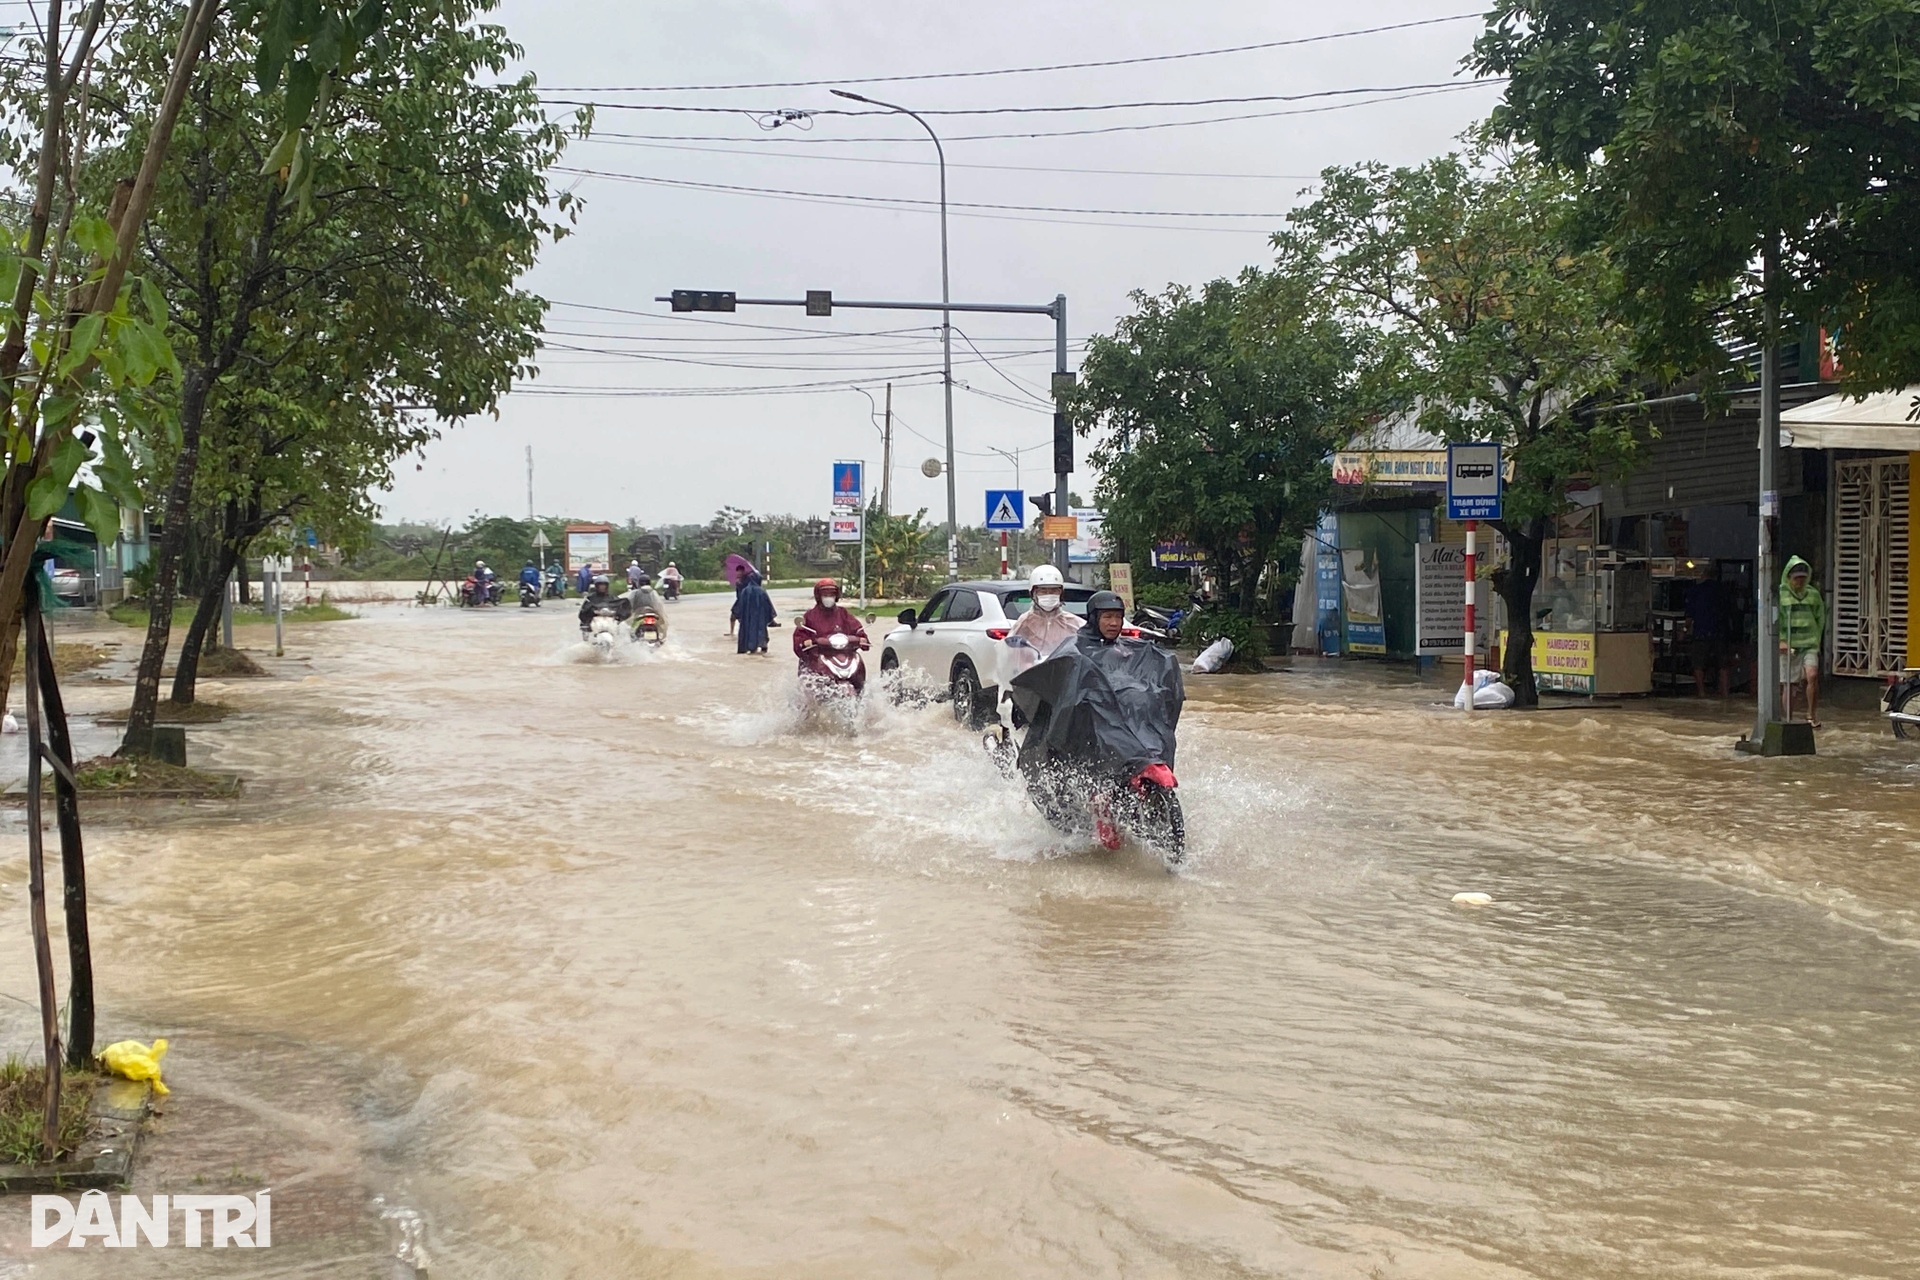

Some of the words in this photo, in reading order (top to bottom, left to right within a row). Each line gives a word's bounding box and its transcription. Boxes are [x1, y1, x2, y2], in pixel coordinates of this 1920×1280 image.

[1453, 499, 1473, 507] TRẠM
[1475, 497, 1496, 506] DỪNG
[1459, 508, 1469, 516] XE
[1470, 507, 1490, 516] BUÝT
[1421, 547, 1454, 564] Mai
[1455, 548, 1485, 564] Sa
[1546, 638, 1578, 650] HAMBURGER
[1579, 639, 1590, 651] 15K
